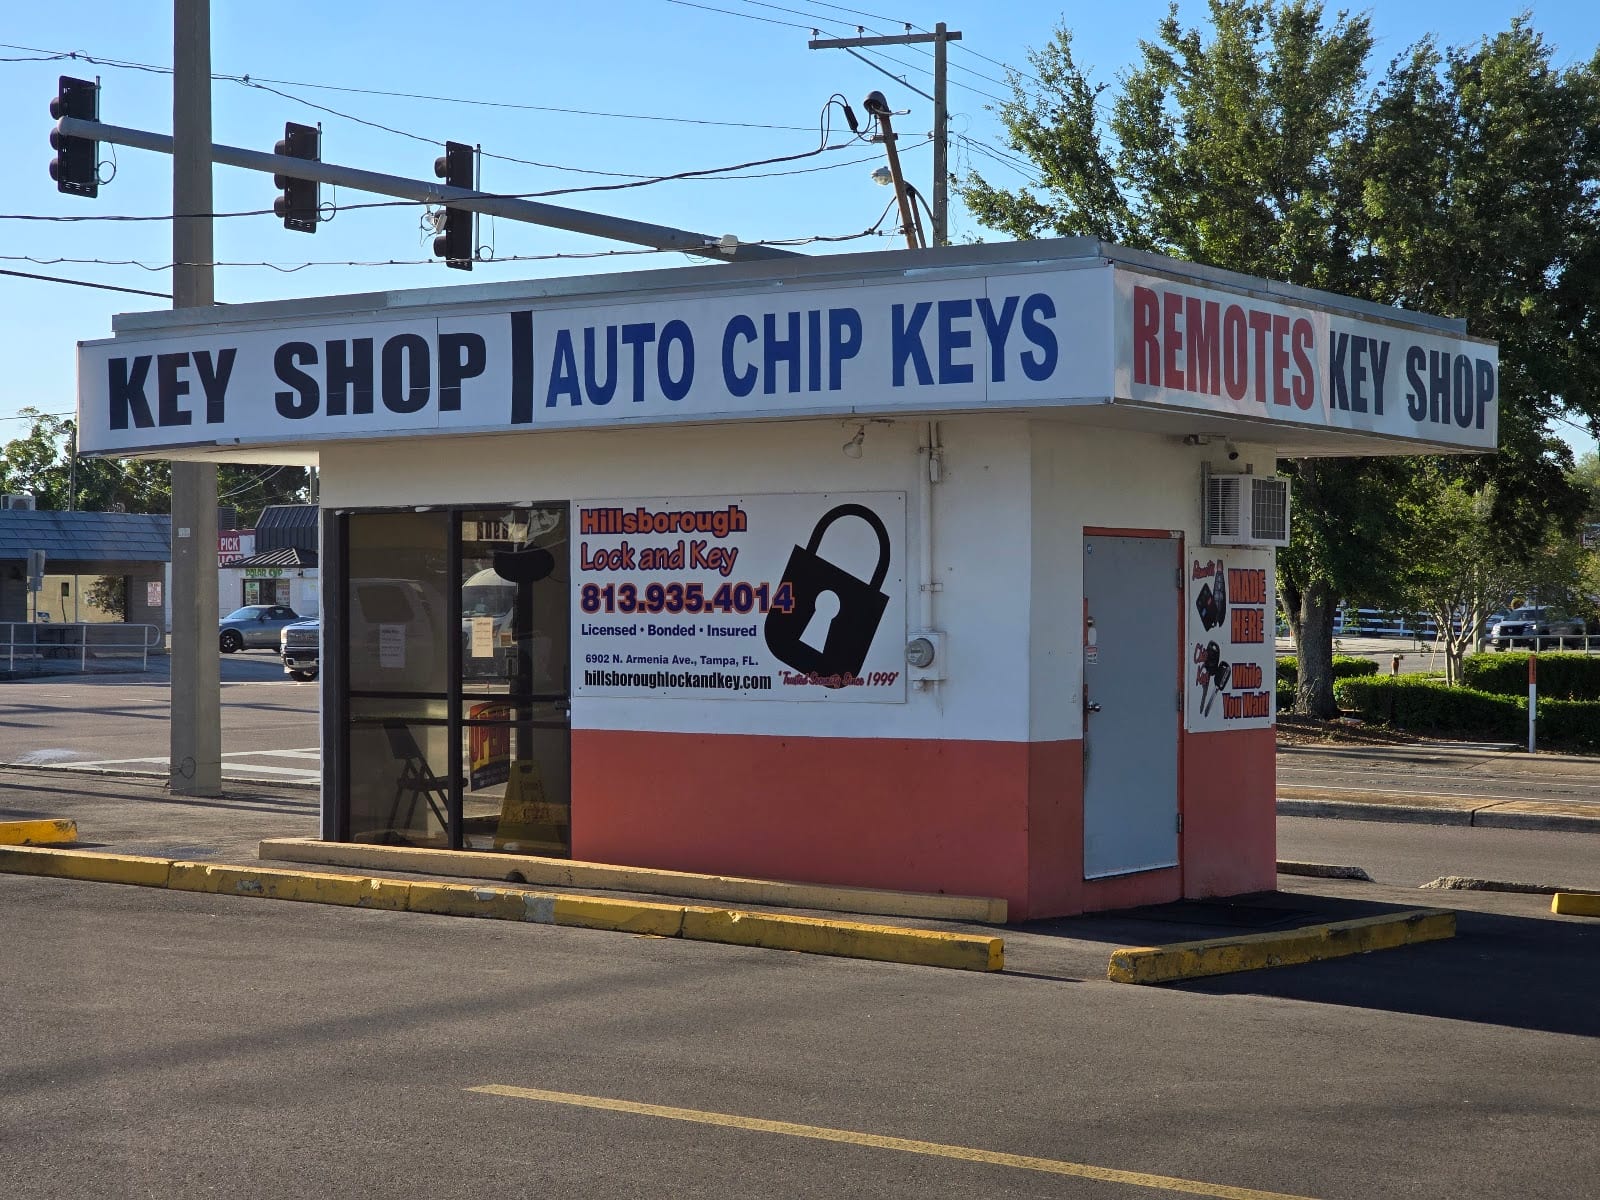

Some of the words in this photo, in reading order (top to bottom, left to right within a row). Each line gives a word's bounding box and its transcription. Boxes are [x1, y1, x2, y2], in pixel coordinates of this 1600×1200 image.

[545, 318, 696, 408] AUTO
[721, 307, 863, 398] CHIP
[891, 292, 1059, 388] KEYS
[1133, 285, 1315, 411] REMOTES
[107, 347, 238, 431] KEY
[273, 332, 487, 420] SHOP
[1329, 330, 1391, 416] KEY
[1404, 345, 1495, 430] SHOP
[580, 505, 748, 538] Hillsborough
[220, 537, 239, 551] PICK
[580, 541, 636, 571] Lock
[638, 540, 685, 570] and
[690, 540, 739, 577] Key
[580, 582, 796, 615] 813.935.4014
[1228, 568, 1267, 605] MADE
[581, 623, 637, 636] Licensed
[647, 624, 696, 637] Bonded
[707, 624, 757, 637] Insured
[1231, 608, 1265, 644] HERE
[585, 654, 610, 664] 6902
[612, 654, 624, 664] N.
[625, 654, 669, 665] Armenia
[672, 655, 698, 666] Ave.,
[700, 655, 739, 668] Tampa,
[742, 655, 759, 666] FL.
[1231, 662, 1263, 690] While
[584, 669, 772, 690] hillsboroughlockandkey.com
[1222, 692, 1242, 720] You
[1242, 691, 1271, 719] Wait!
